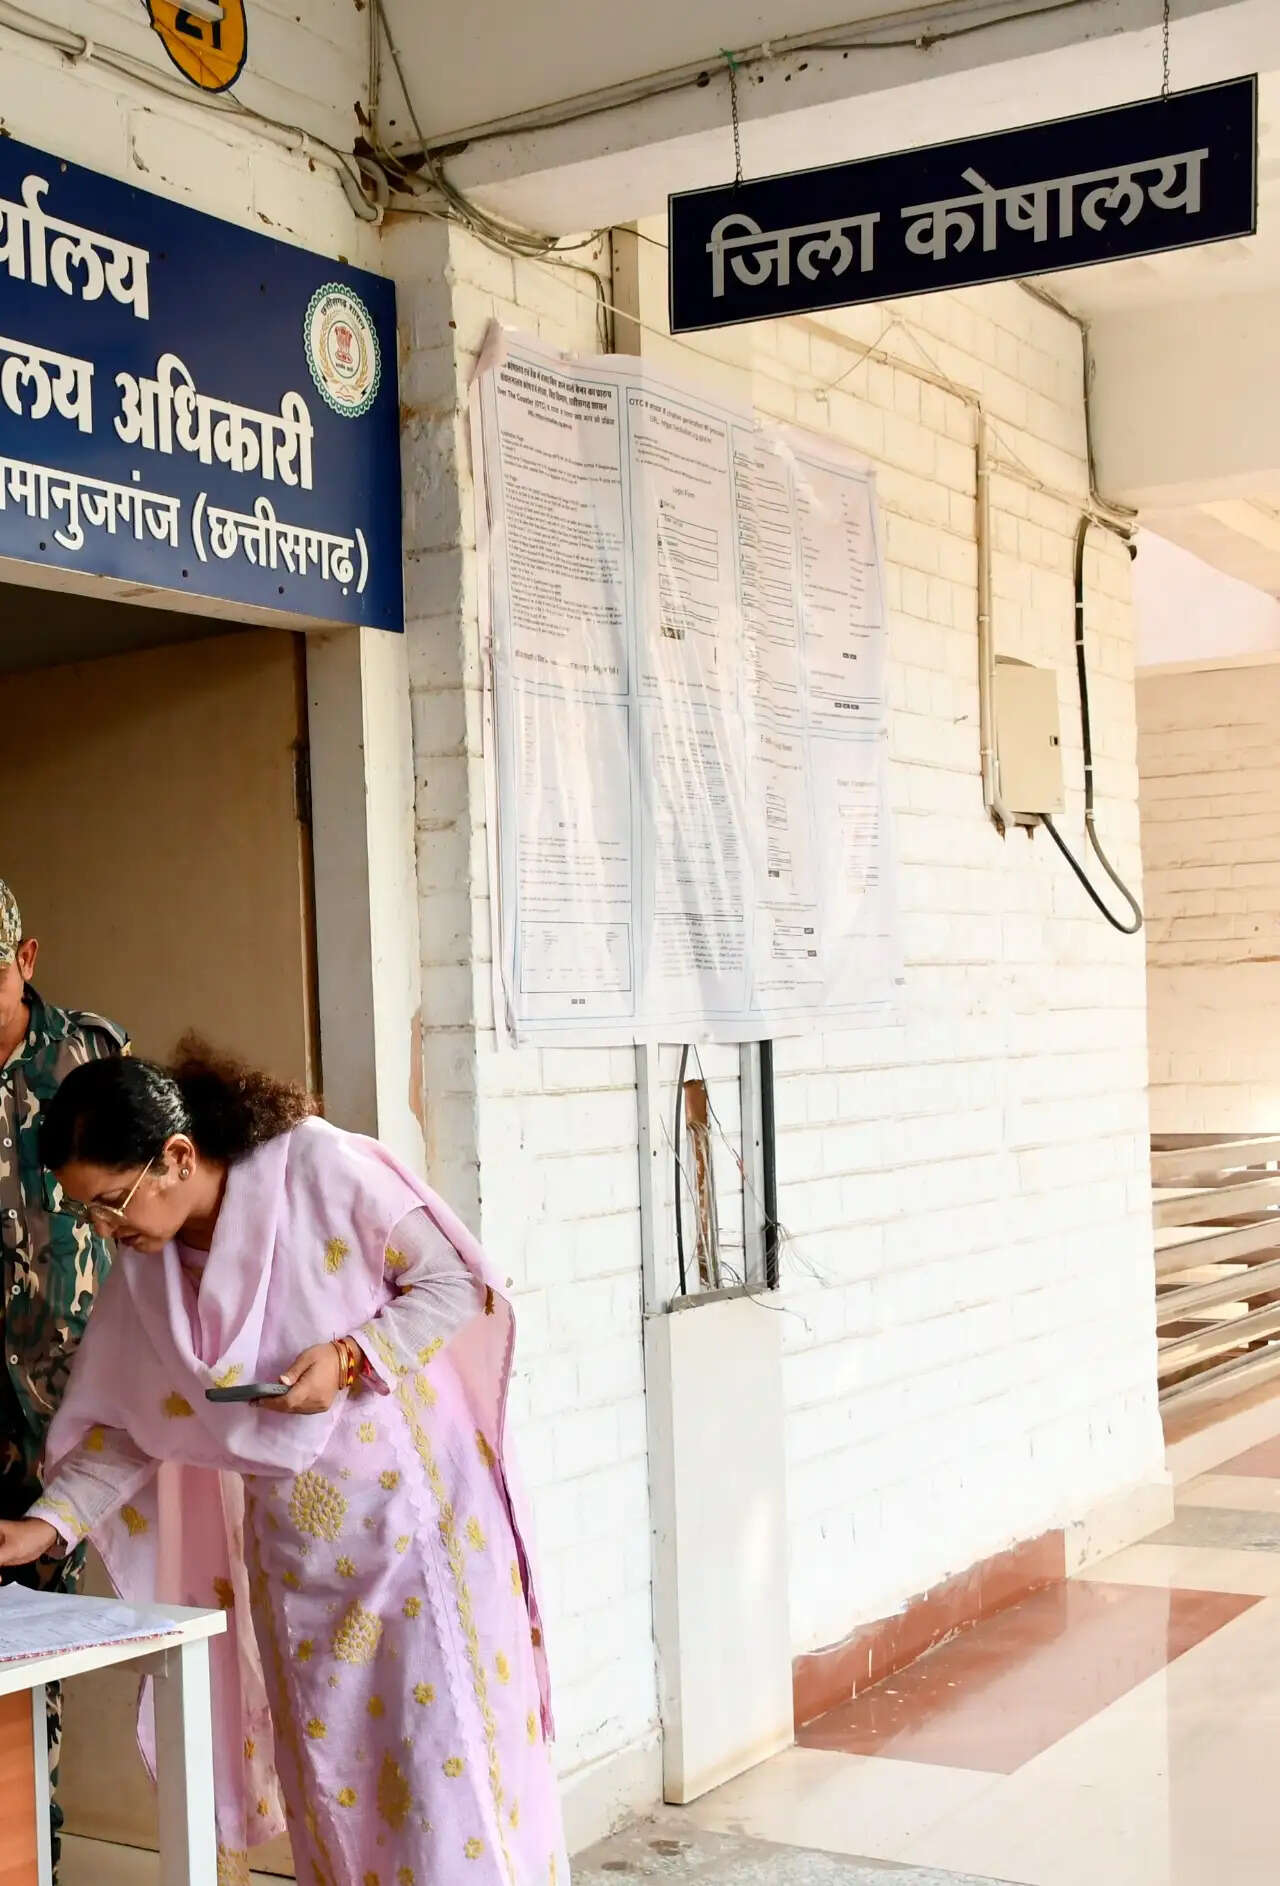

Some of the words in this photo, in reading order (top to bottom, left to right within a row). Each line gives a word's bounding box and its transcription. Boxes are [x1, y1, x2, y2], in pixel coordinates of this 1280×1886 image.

[705, 212, 880, 298] जिला
[900, 147, 1210, 261] कोषालय
[114, 352, 313, 491] अधिकारी
[190, 491, 369, 598] (छत्तीसगढ़)
